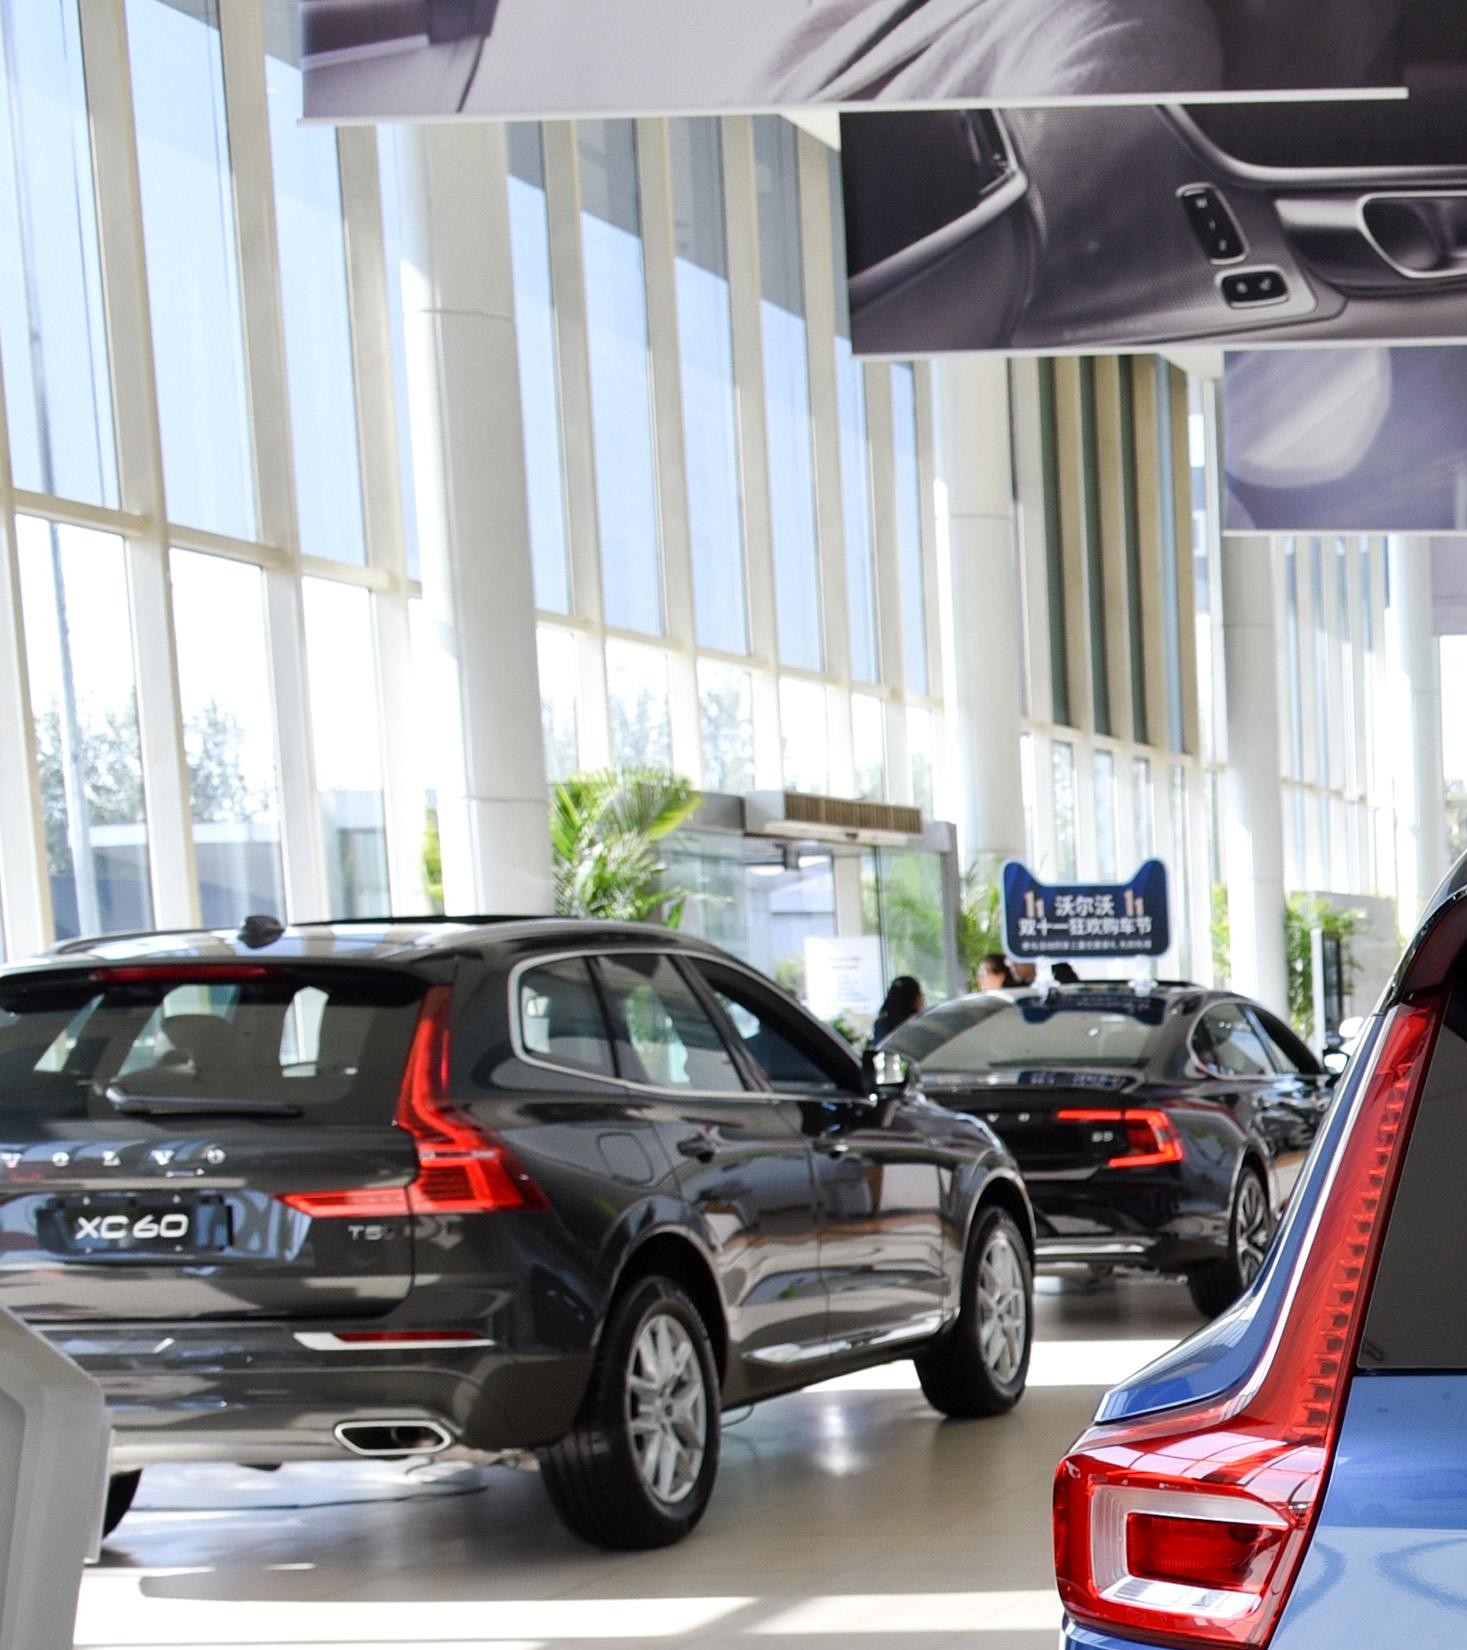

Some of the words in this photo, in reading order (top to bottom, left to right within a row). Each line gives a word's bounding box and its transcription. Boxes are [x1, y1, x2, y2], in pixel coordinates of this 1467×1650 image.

[1054, 894, 1115, 917] 沃尔沃
[1018, 916, 1152, 936] 双十一狂欢购车节
[1, 1147, 226, 1169] VOLVO
